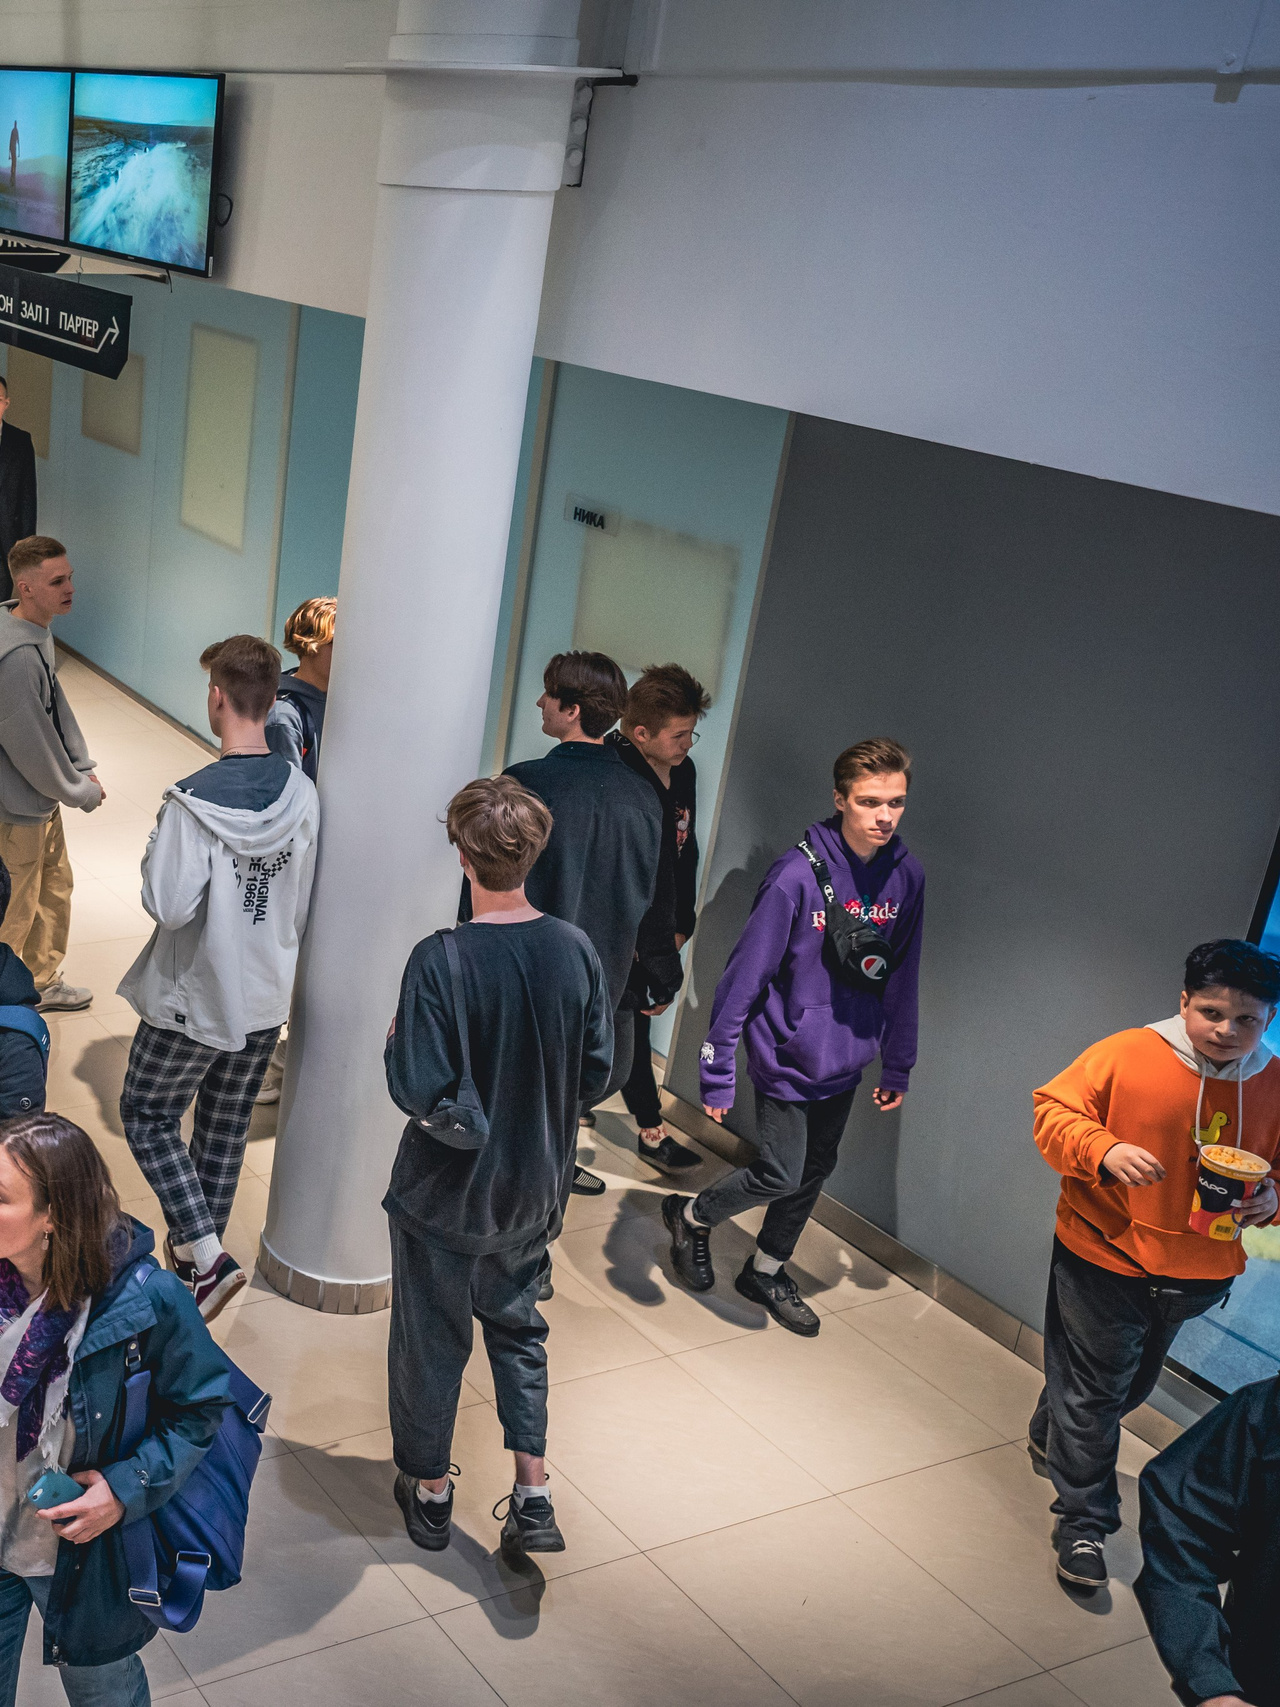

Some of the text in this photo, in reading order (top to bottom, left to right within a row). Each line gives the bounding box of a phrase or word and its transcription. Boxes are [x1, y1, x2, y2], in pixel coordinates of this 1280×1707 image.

[20, 300, 42, 323] ЗАЛ
[44, 307, 50, 325] 1
[59, 311, 99, 339] ПАРТЕР
[573, 506, 605, 530] НИКА
[243, 876, 258, 907] 1966
